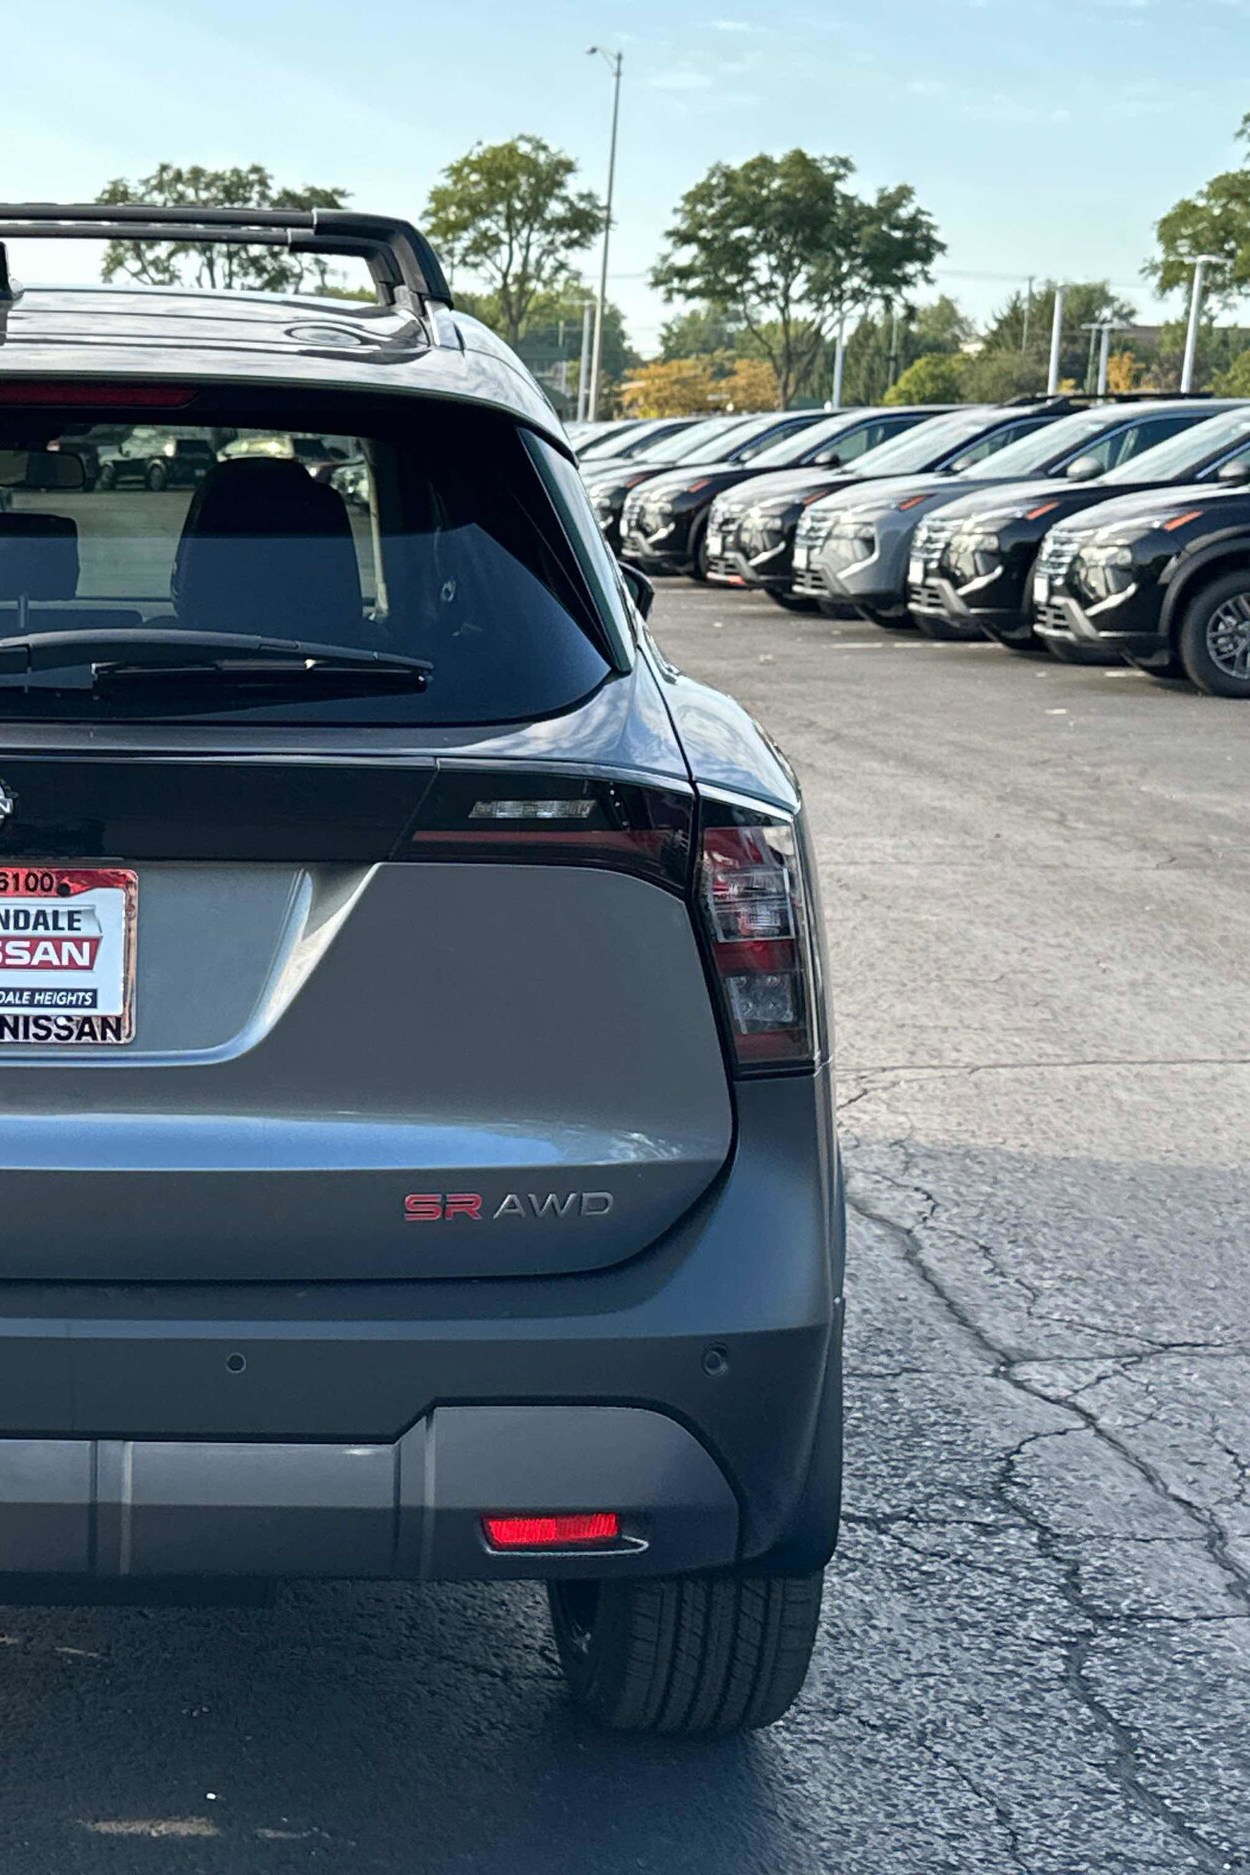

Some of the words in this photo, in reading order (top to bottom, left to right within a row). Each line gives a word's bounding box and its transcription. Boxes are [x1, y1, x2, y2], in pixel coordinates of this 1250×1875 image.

[34, 991, 94, 1006] HEIGHTS
[403, 1193, 483, 1221] SR
[492, 1191, 615, 1219] AWD
